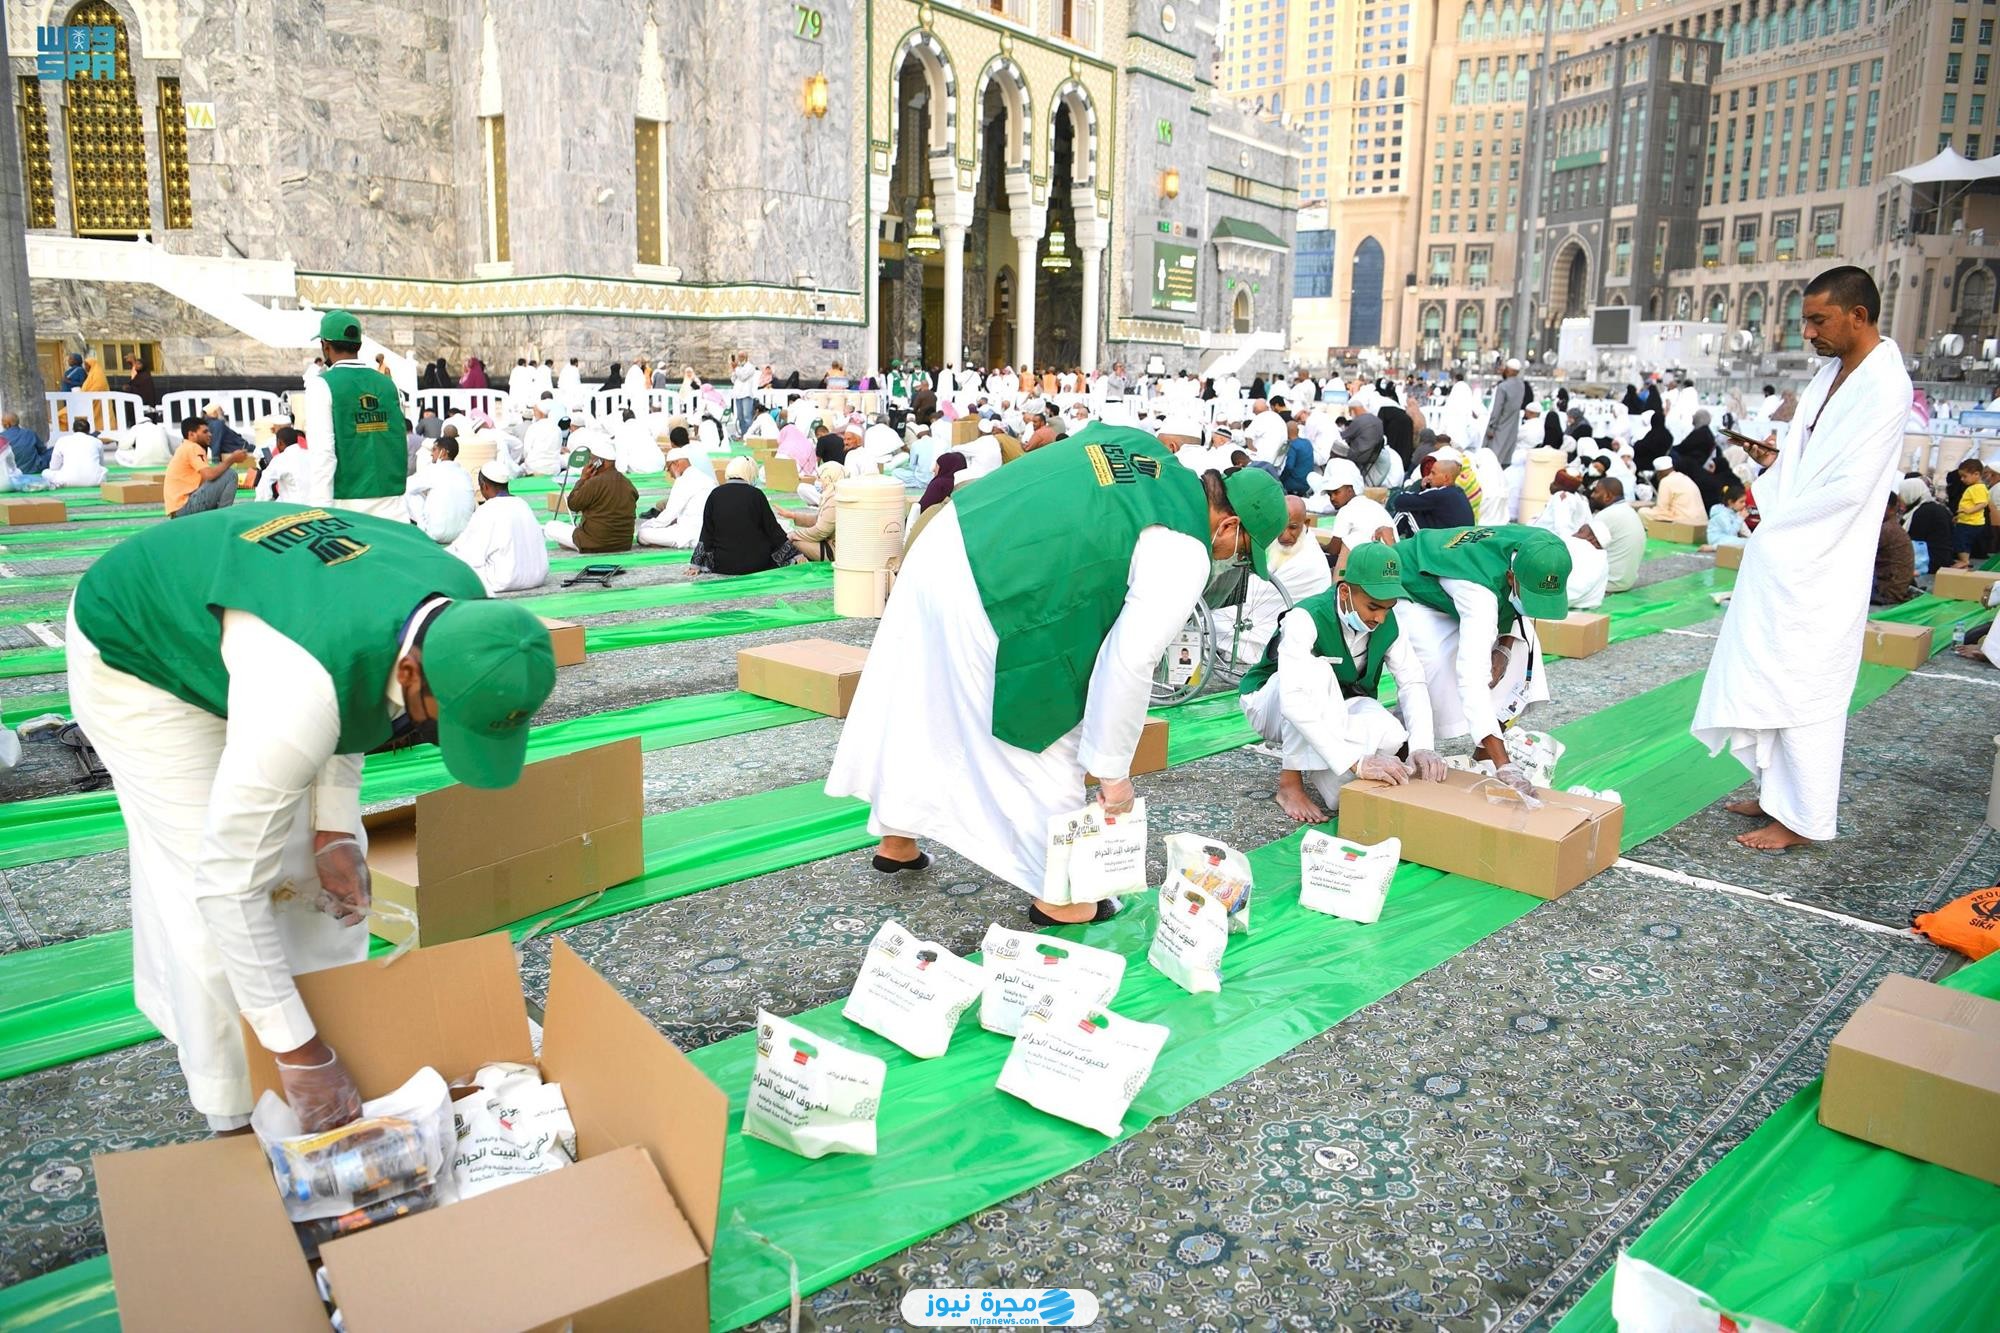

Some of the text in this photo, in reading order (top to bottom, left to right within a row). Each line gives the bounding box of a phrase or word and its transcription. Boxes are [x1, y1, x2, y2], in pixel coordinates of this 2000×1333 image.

[793, 4, 822, 38] 79
[1969, 918, 1995, 931] SIKH
[774, 1085, 796, 1101] البيت
[452, 1147, 489, 1171] الحرام
[491, 1144, 520, 1160] البيت
